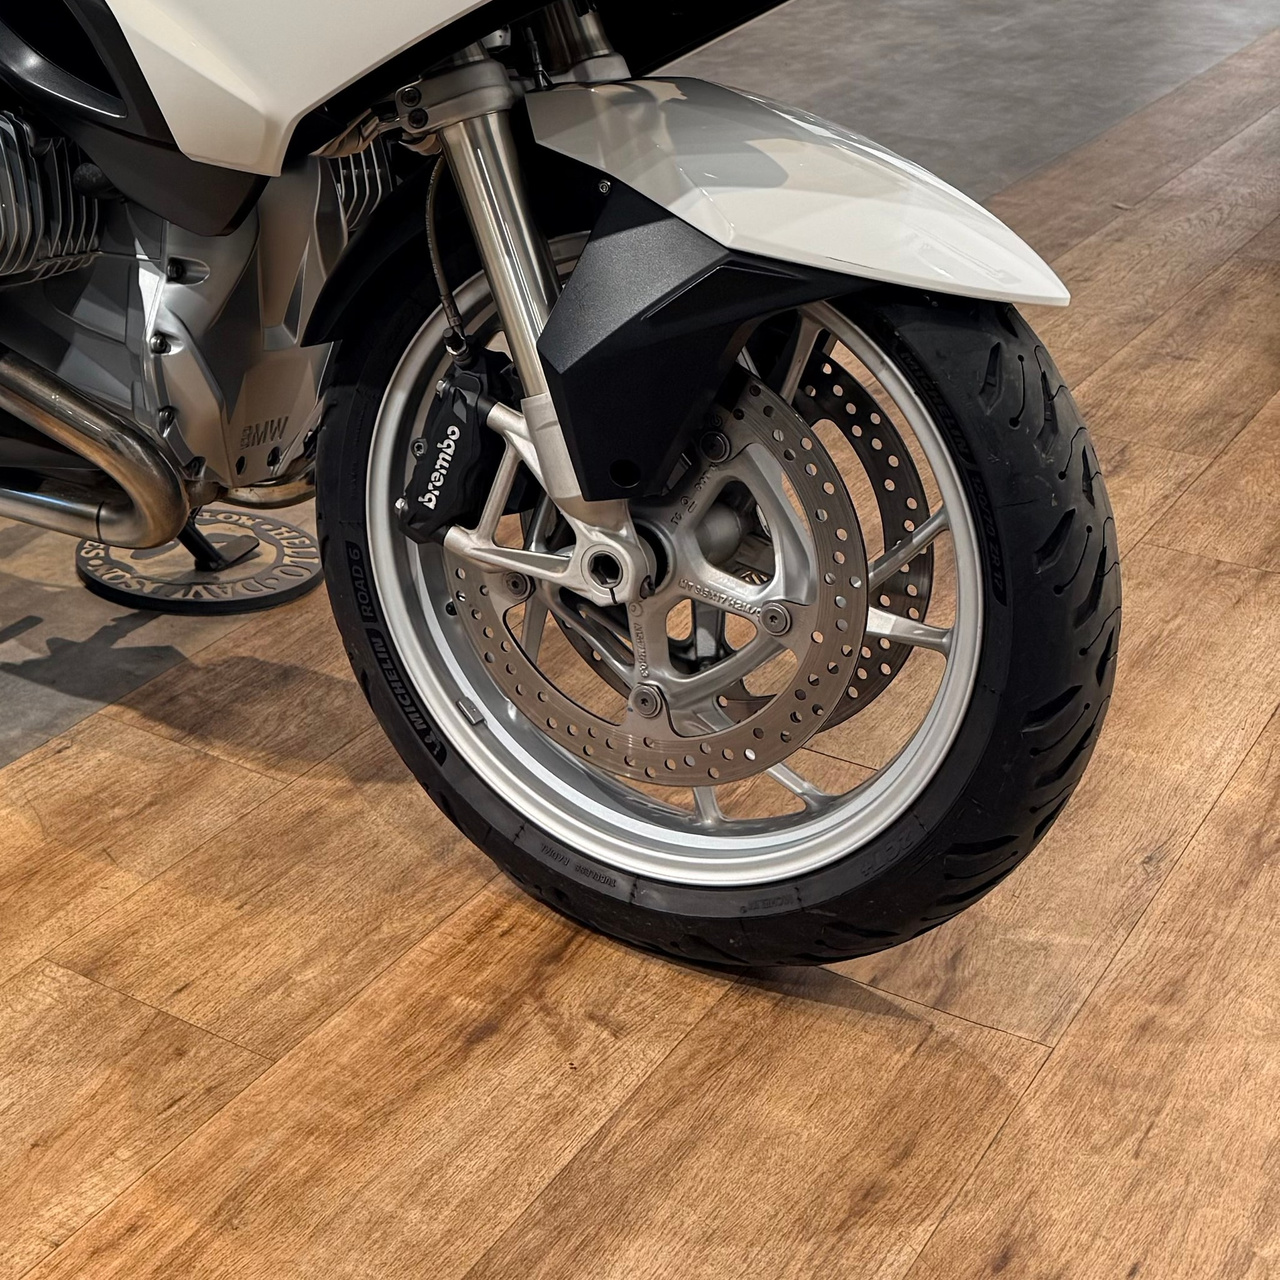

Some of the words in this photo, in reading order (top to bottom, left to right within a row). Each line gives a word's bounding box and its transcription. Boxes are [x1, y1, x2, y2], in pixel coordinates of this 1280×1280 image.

[240, 415, 289, 450] BMW
[898, 350, 971, 455] MICHELIN
[418, 425, 461, 510] brembo
[268, 526, 320, 579] HELLO
[352, 567, 375, 618] ROAD
[371, 638, 427, 731] MICHELIN
